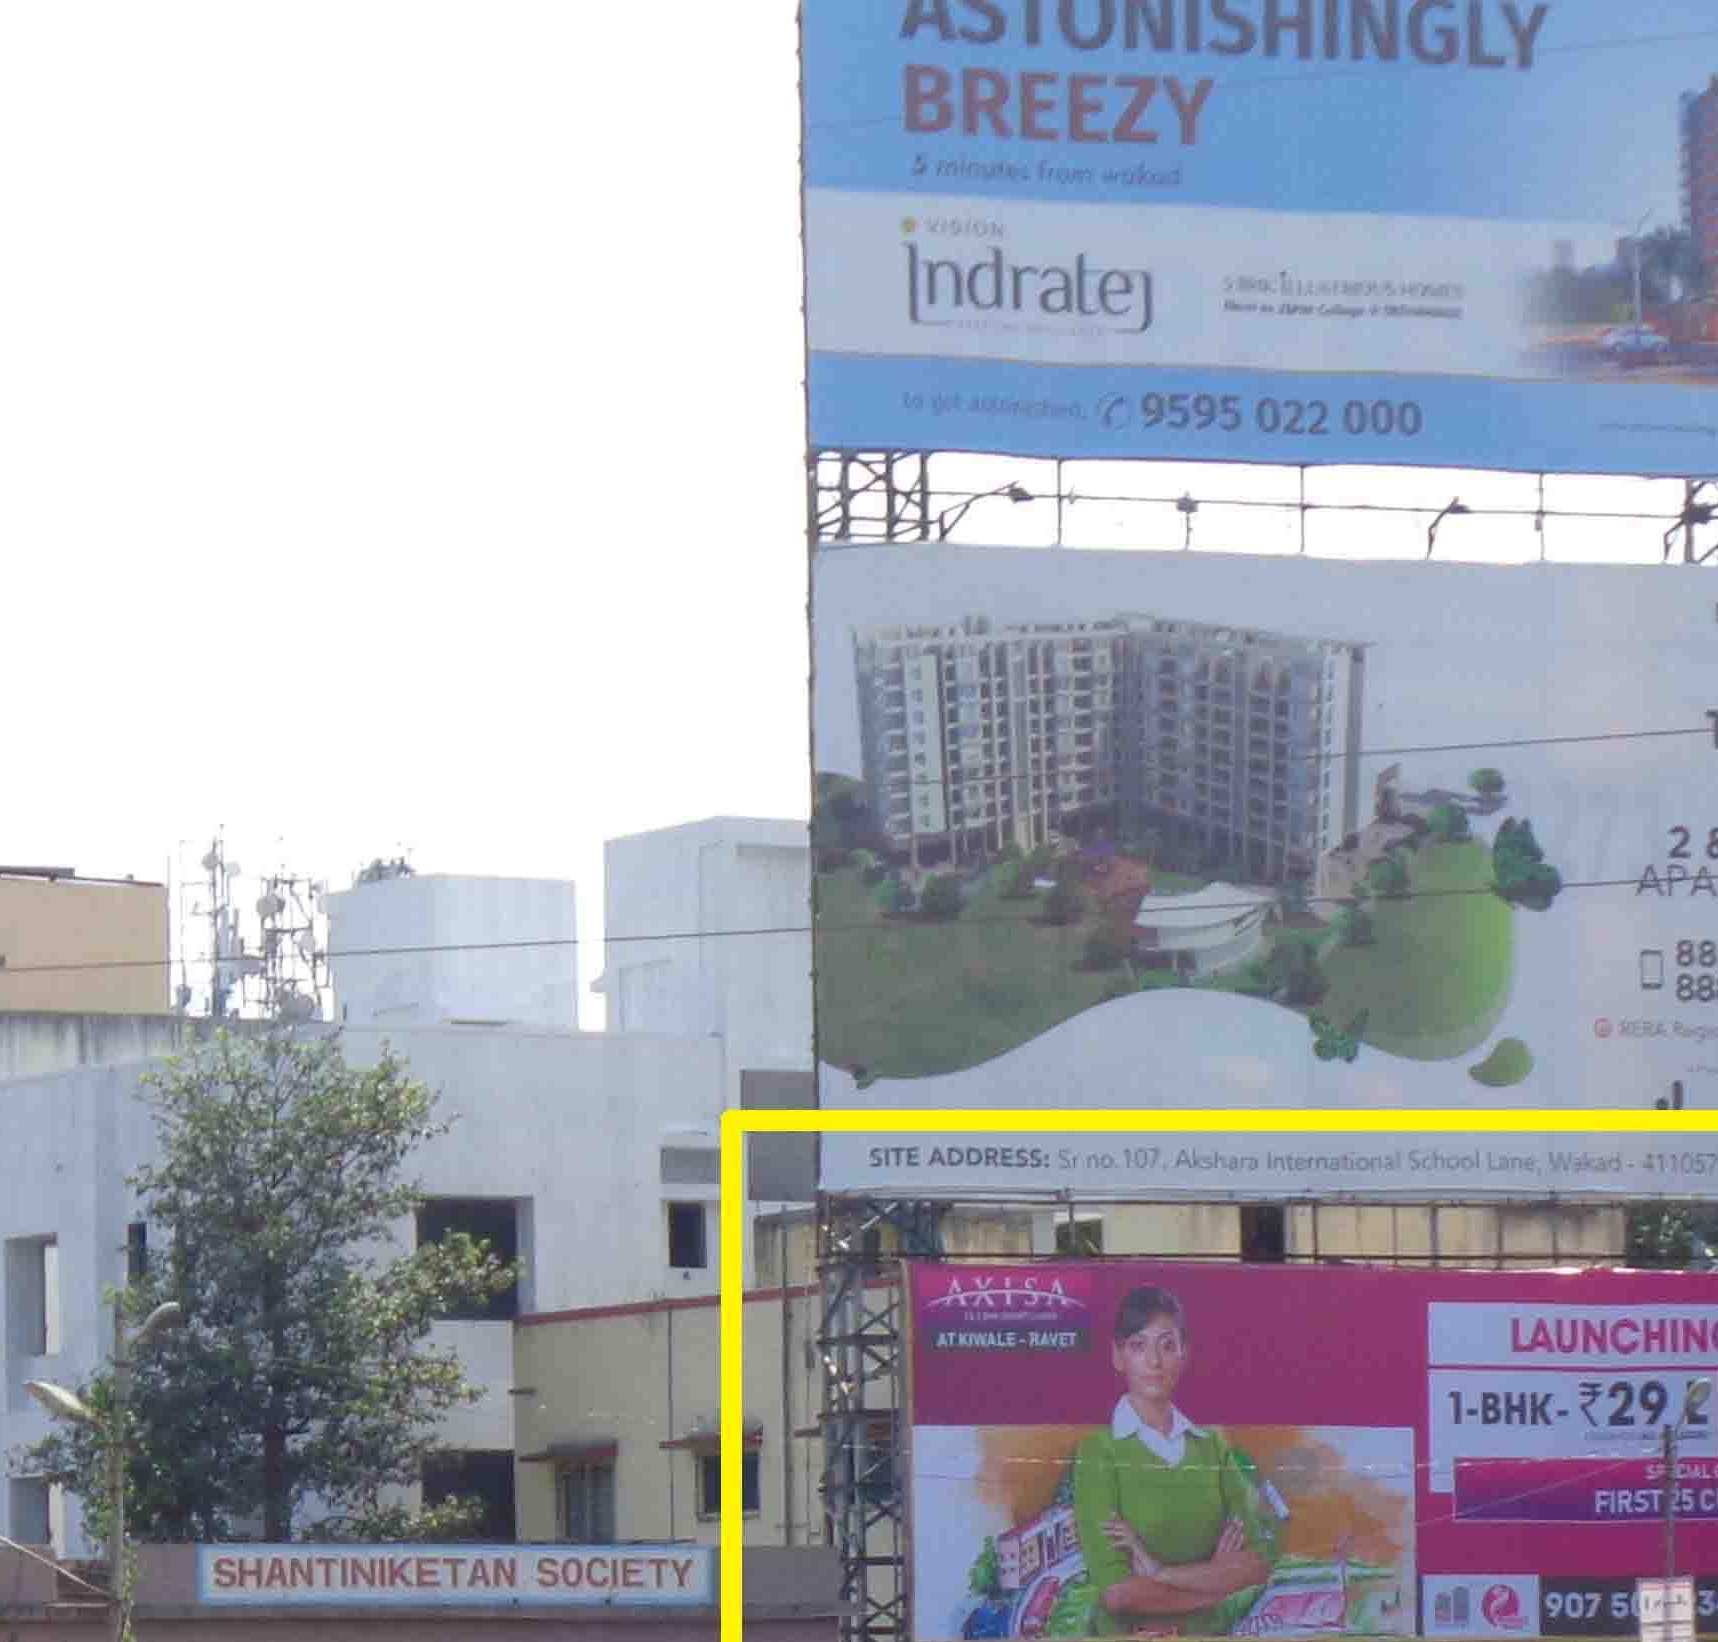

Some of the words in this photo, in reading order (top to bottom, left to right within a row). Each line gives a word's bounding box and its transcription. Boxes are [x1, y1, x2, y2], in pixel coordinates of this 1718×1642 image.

[899, 0, 1548, 69] ASTONISHINGLY
[902, 64, 1215, 145] BREEZY
[1034, 159, 1093, 185] from
[1140, 393, 1243, 432] 9595
[1254, 397, 1331, 436] 022
[1341, 399, 1423, 437] 000
[1668, 826, 1692, 861] 2
[868, 1146, 920, 1168] SITE
[928, 1147, 1051, 1169] ADDRESS:
[1175, 1150, 1260, 1171] Akshara
[1266, 1150, 1402, 1173] International
[1409, 1149, 1481, 1173] School
[1487, 1152, 1542, 1176] Lane,
[1547, 1151, 1622, 1175] Wakad
[1642, 1152, 1717, 1176] 411057
[944, 1276, 1072, 1309] AXISA
[936, 1330, 957, 1348] AT
[957, 1330, 1019, 1348] KIWALE
[1028, 1331, 1077, 1349] RAVET
[1594, 1488, 1662, 1514] FIRST
[213, 1556, 517, 1589] SHANTINIKETAN
[536, 1556, 695, 1590] SOCIETY
[1545, 1593, 1601, 1620] 907
